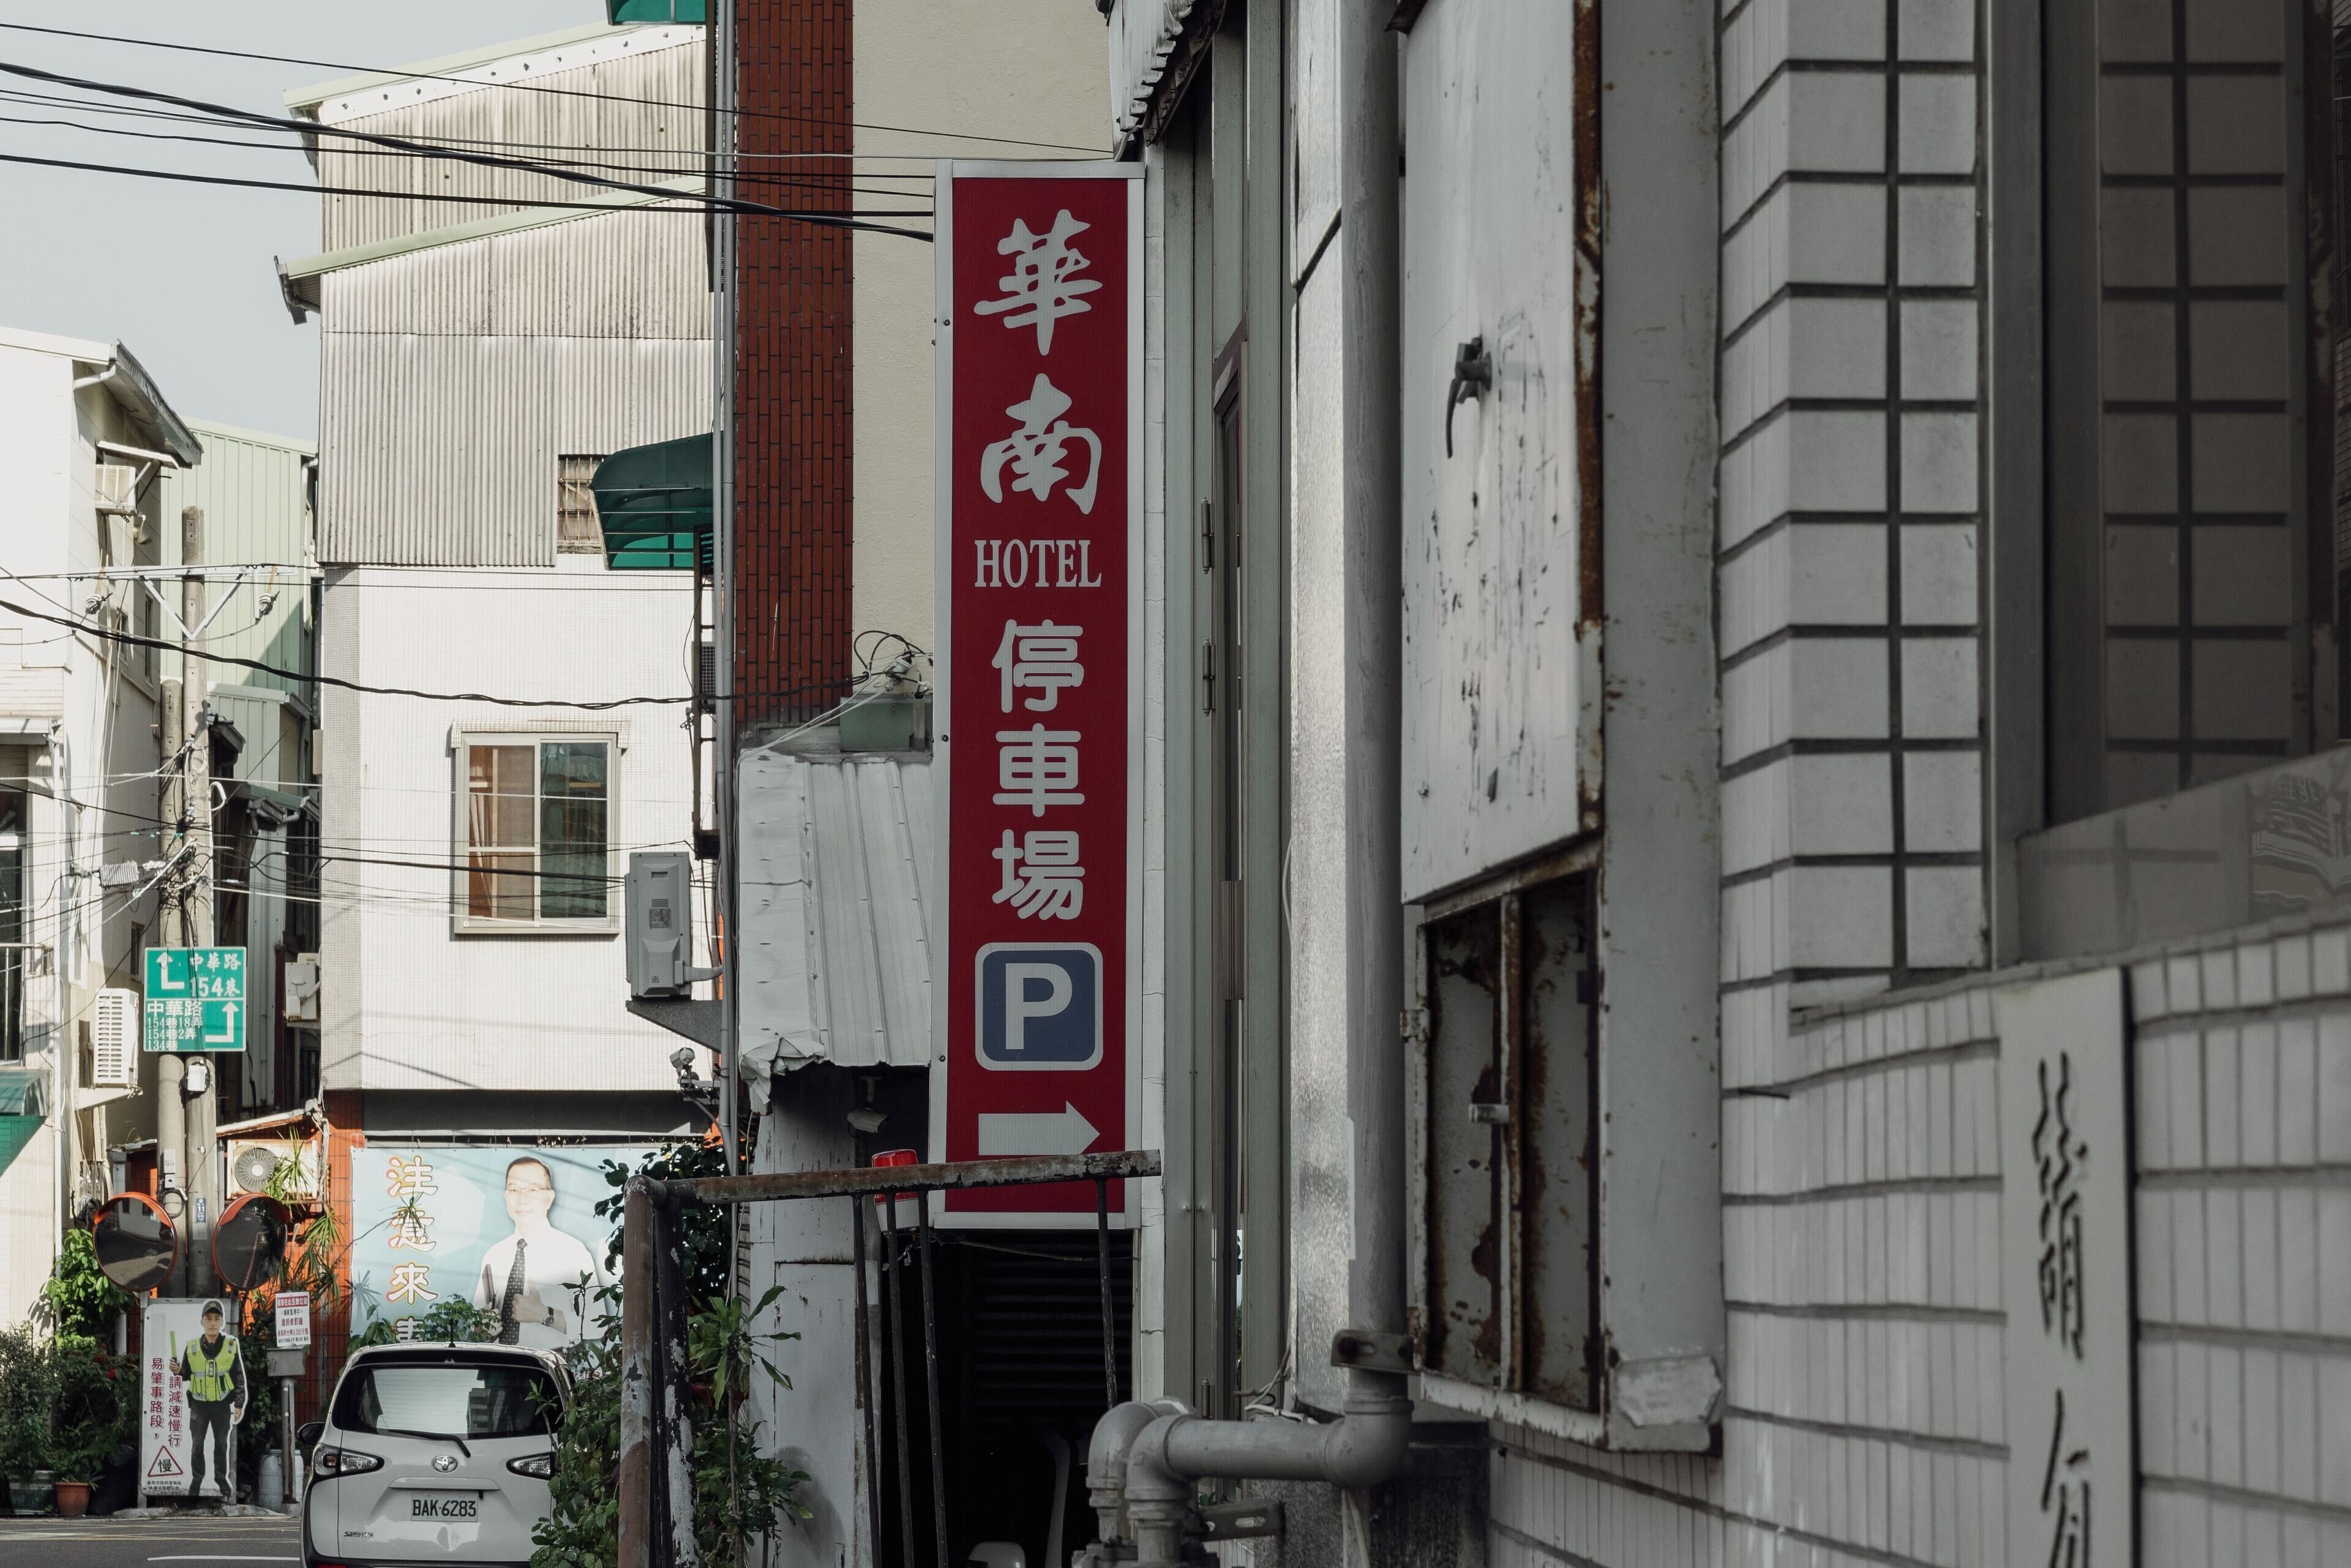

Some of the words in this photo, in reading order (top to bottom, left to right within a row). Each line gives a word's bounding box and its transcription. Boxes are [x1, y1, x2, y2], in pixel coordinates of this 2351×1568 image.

[973, 209, 1103, 515] 華南
[974, 539, 1102, 588] HOTEL
[992, 619, 1085, 921] 停車場
[189, 951, 242, 972] 中華路
[190, 977, 241, 997] 154巷
[147, 1000, 203, 1017] 中華路
[1005, 962, 1073, 1050] P
[147, 1017, 203, 1029] 154巷18弄
[147, 1029, 197, 1040] 154巷2弄
[147, 1040, 178, 1051] 134巷
[168, 1376, 182, 1447] 請減速慢行
[158, 1458, 172, 1473] 慢
